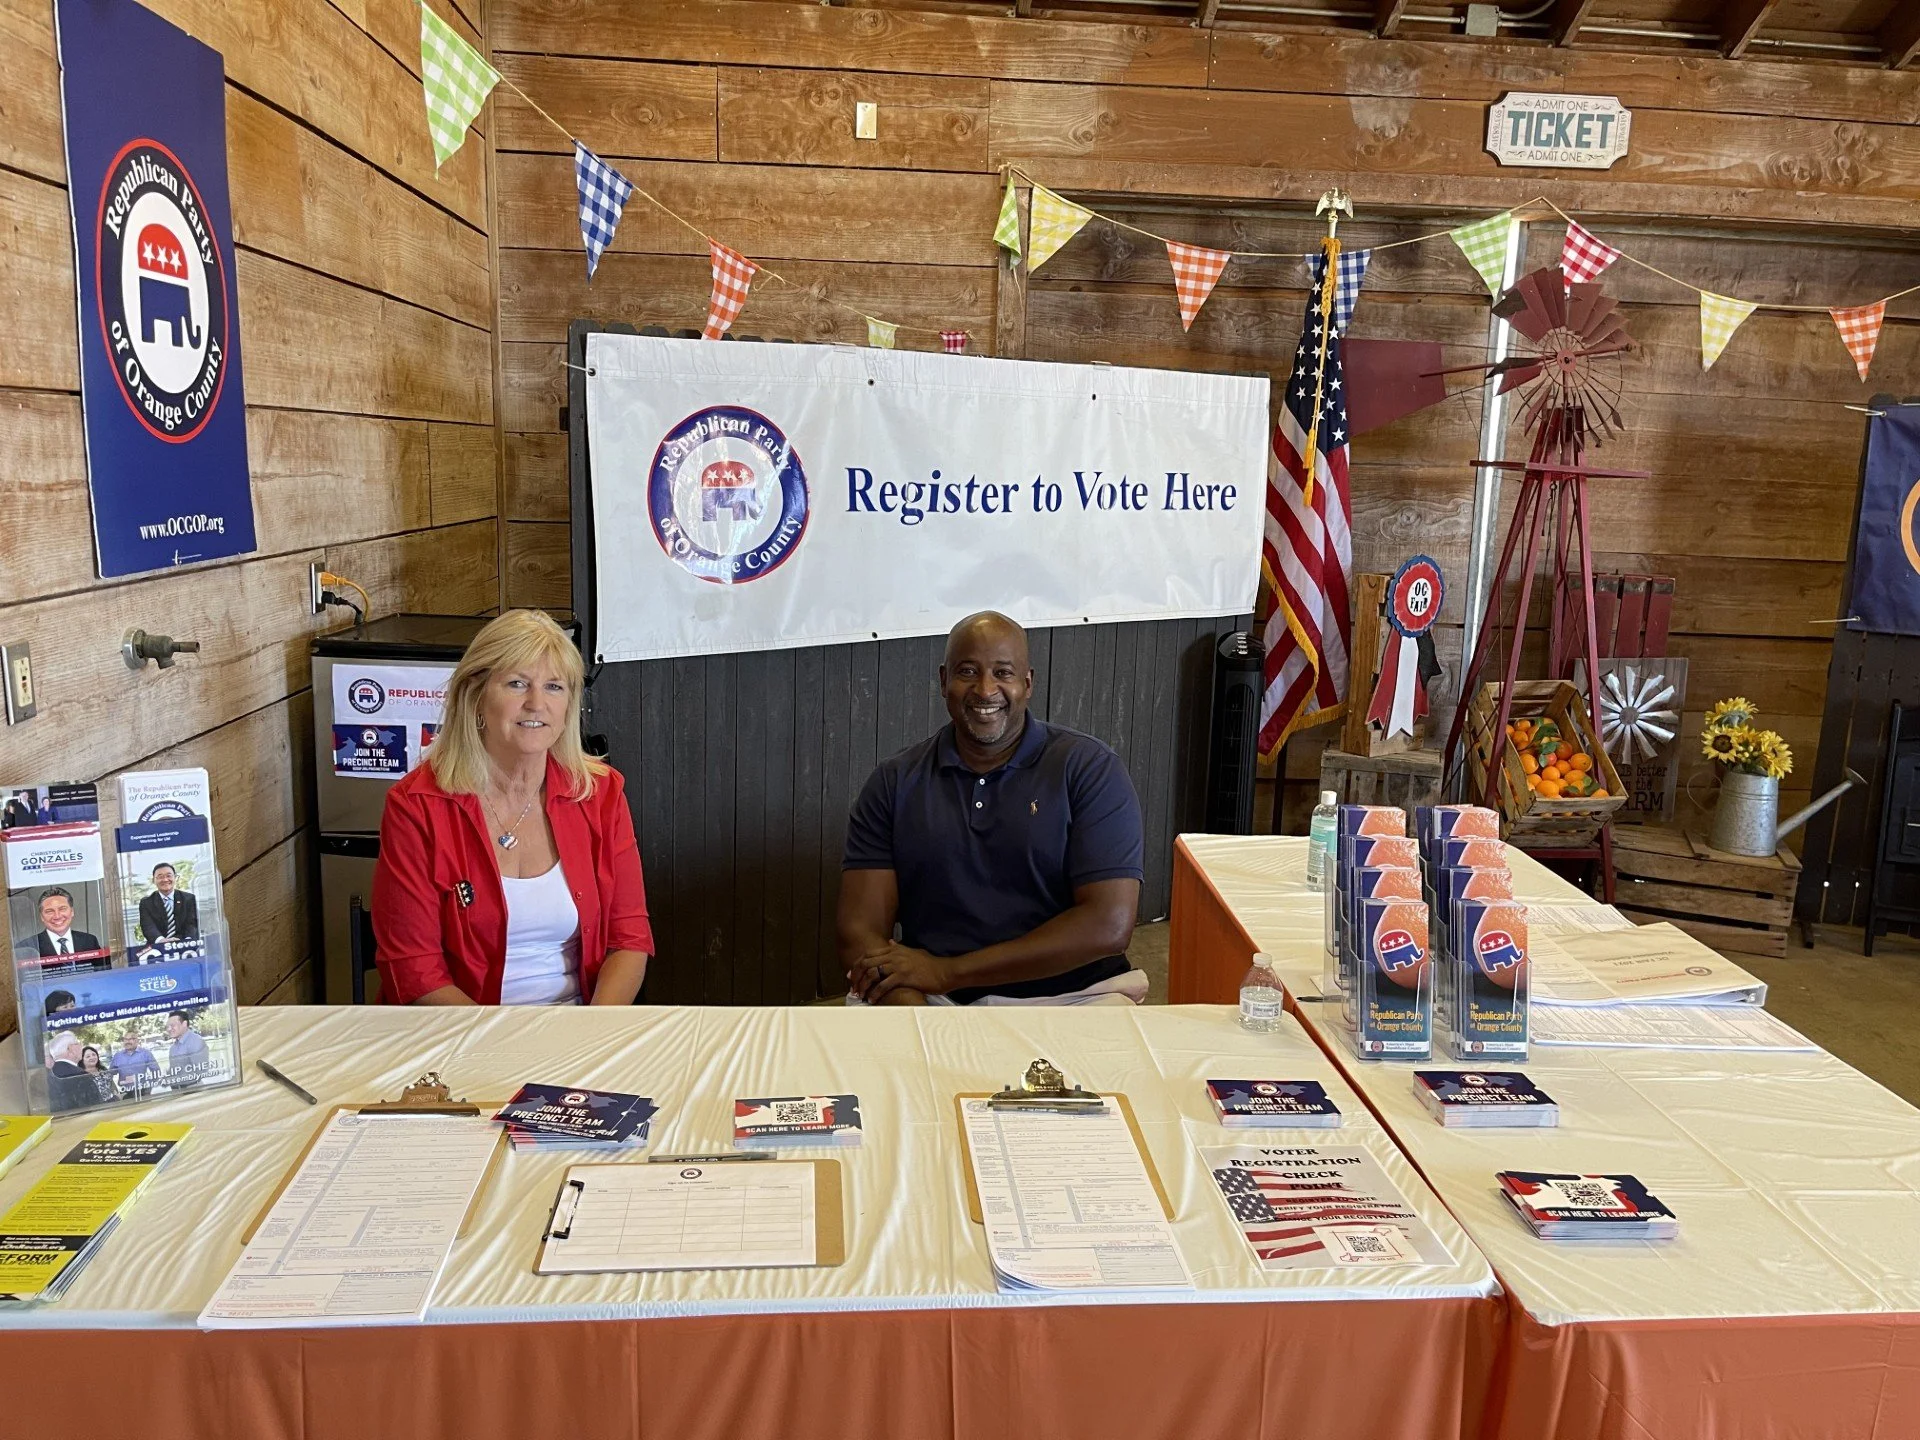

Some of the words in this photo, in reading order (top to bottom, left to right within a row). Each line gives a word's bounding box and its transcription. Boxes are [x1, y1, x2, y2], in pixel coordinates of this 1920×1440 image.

[1534, 99, 1565, 110] ADMIT
[1567, 101, 1589, 111] ONE
[1507, 110, 1615, 149] TICKET
[1527, 150, 1558, 161] ADMIT
[1560, 151, 1582, 162] ONE
[105, 155, 178, 240] Republican
[181, 183, 214, 264] Party
[112, 321, 130, 355] of
[126, 358, 182, 430] Orange
[185, 336, 222, 419] County
[660, 416, 751, 472] Republican
[754, 424, 791, 473] Party
[844, 466, 1019, 526] Register
[1031, 474, 1062, 514] to
[1072, 470, 1148, 512] Vote
[1163, 471, 1238, 512] Here
[140, 514, 224, 540] www.OCGOP.org
[660, 517, 683, 538] of
[675, 537, 741, 576] Orange
[745, 515, 802, 569] County
[1414, 582, 1428, 596] OC
[1410, 597, 1428, 612] FAIR
[353, 748, 370, 757] JOIN
[371, 748, 386, 757] THE
[343, 757, 377, 767] PRECINCT
[378, 758, 400, 767] TEAM
[128, 786, 141, 794] The
[143, 784, 182, 793] Republican
[183, 782, 201, 790] Party
[129, 794, 139, 802] of
[140, 792, 170, 801] Orange
[172, 789, 201, 798] County
[141, 803, 176, 822] Republican
[176, 804, 192, 817] Part
[21, 852, 84, 865] GONZALES
[164, 939, 204, 951] Steven
[140, 974, 169, 983] MICHELLE
[140, 979, 172, 991] STEEL
[47, 1014, 83, 1028] Fighting
[84, 1012, 97, 1022] for
[99, 1010, 114, 1020] Our
[116, 1000, 171, 1018] Middle-Class
[173, 995, 209, 1007] Families
[1370, 1010, 1405, 1021] Republican
[1406, 1010, 1424, 1021] Party
[1470, 1011, 1505, 1021] Republican
[1505, 1011, 1523, 1022] Party
[1376, 1022, 1400, 1032] Orange
[1401, 1022, 1423, 1033] County
[1476, 1022, 1500, 1033] Orange
[1500, 1022, 1522, 1034] County
[138, 1066, 181, 1082] PHILLIP
[185, 1060, 217, 1073] CHEN
[120, 1084, 135, 1093] Our
[1448, 1094, 1501, 1102] PRECINCT
[1503, 1094, 1538, 1102] TEAM
[536, 1105, 565, 1114] JOIN
[567, 1107, 590, 1117] THE
[510, 1110, 568, 1123] PRECINCT
[569, 1115, 605, 1126] TEAM
[83, 1147, 120, 1155] Vote
[1230, 1157, 1361, 1167] REGISTRATION
[1282, 1170, 1343, 1179] CHECK
[1289, 1182, 1343, 1190] POINT
[1546, 1210, 1570, 1218] SCAN
[1572, 1210, 1594, 1218] HERE
[1595, 1210, 1607, 1218] TO
[1609, 1210, 1637, 1218] LEARN
[1637, 1210, 1660, 1218] MORE
